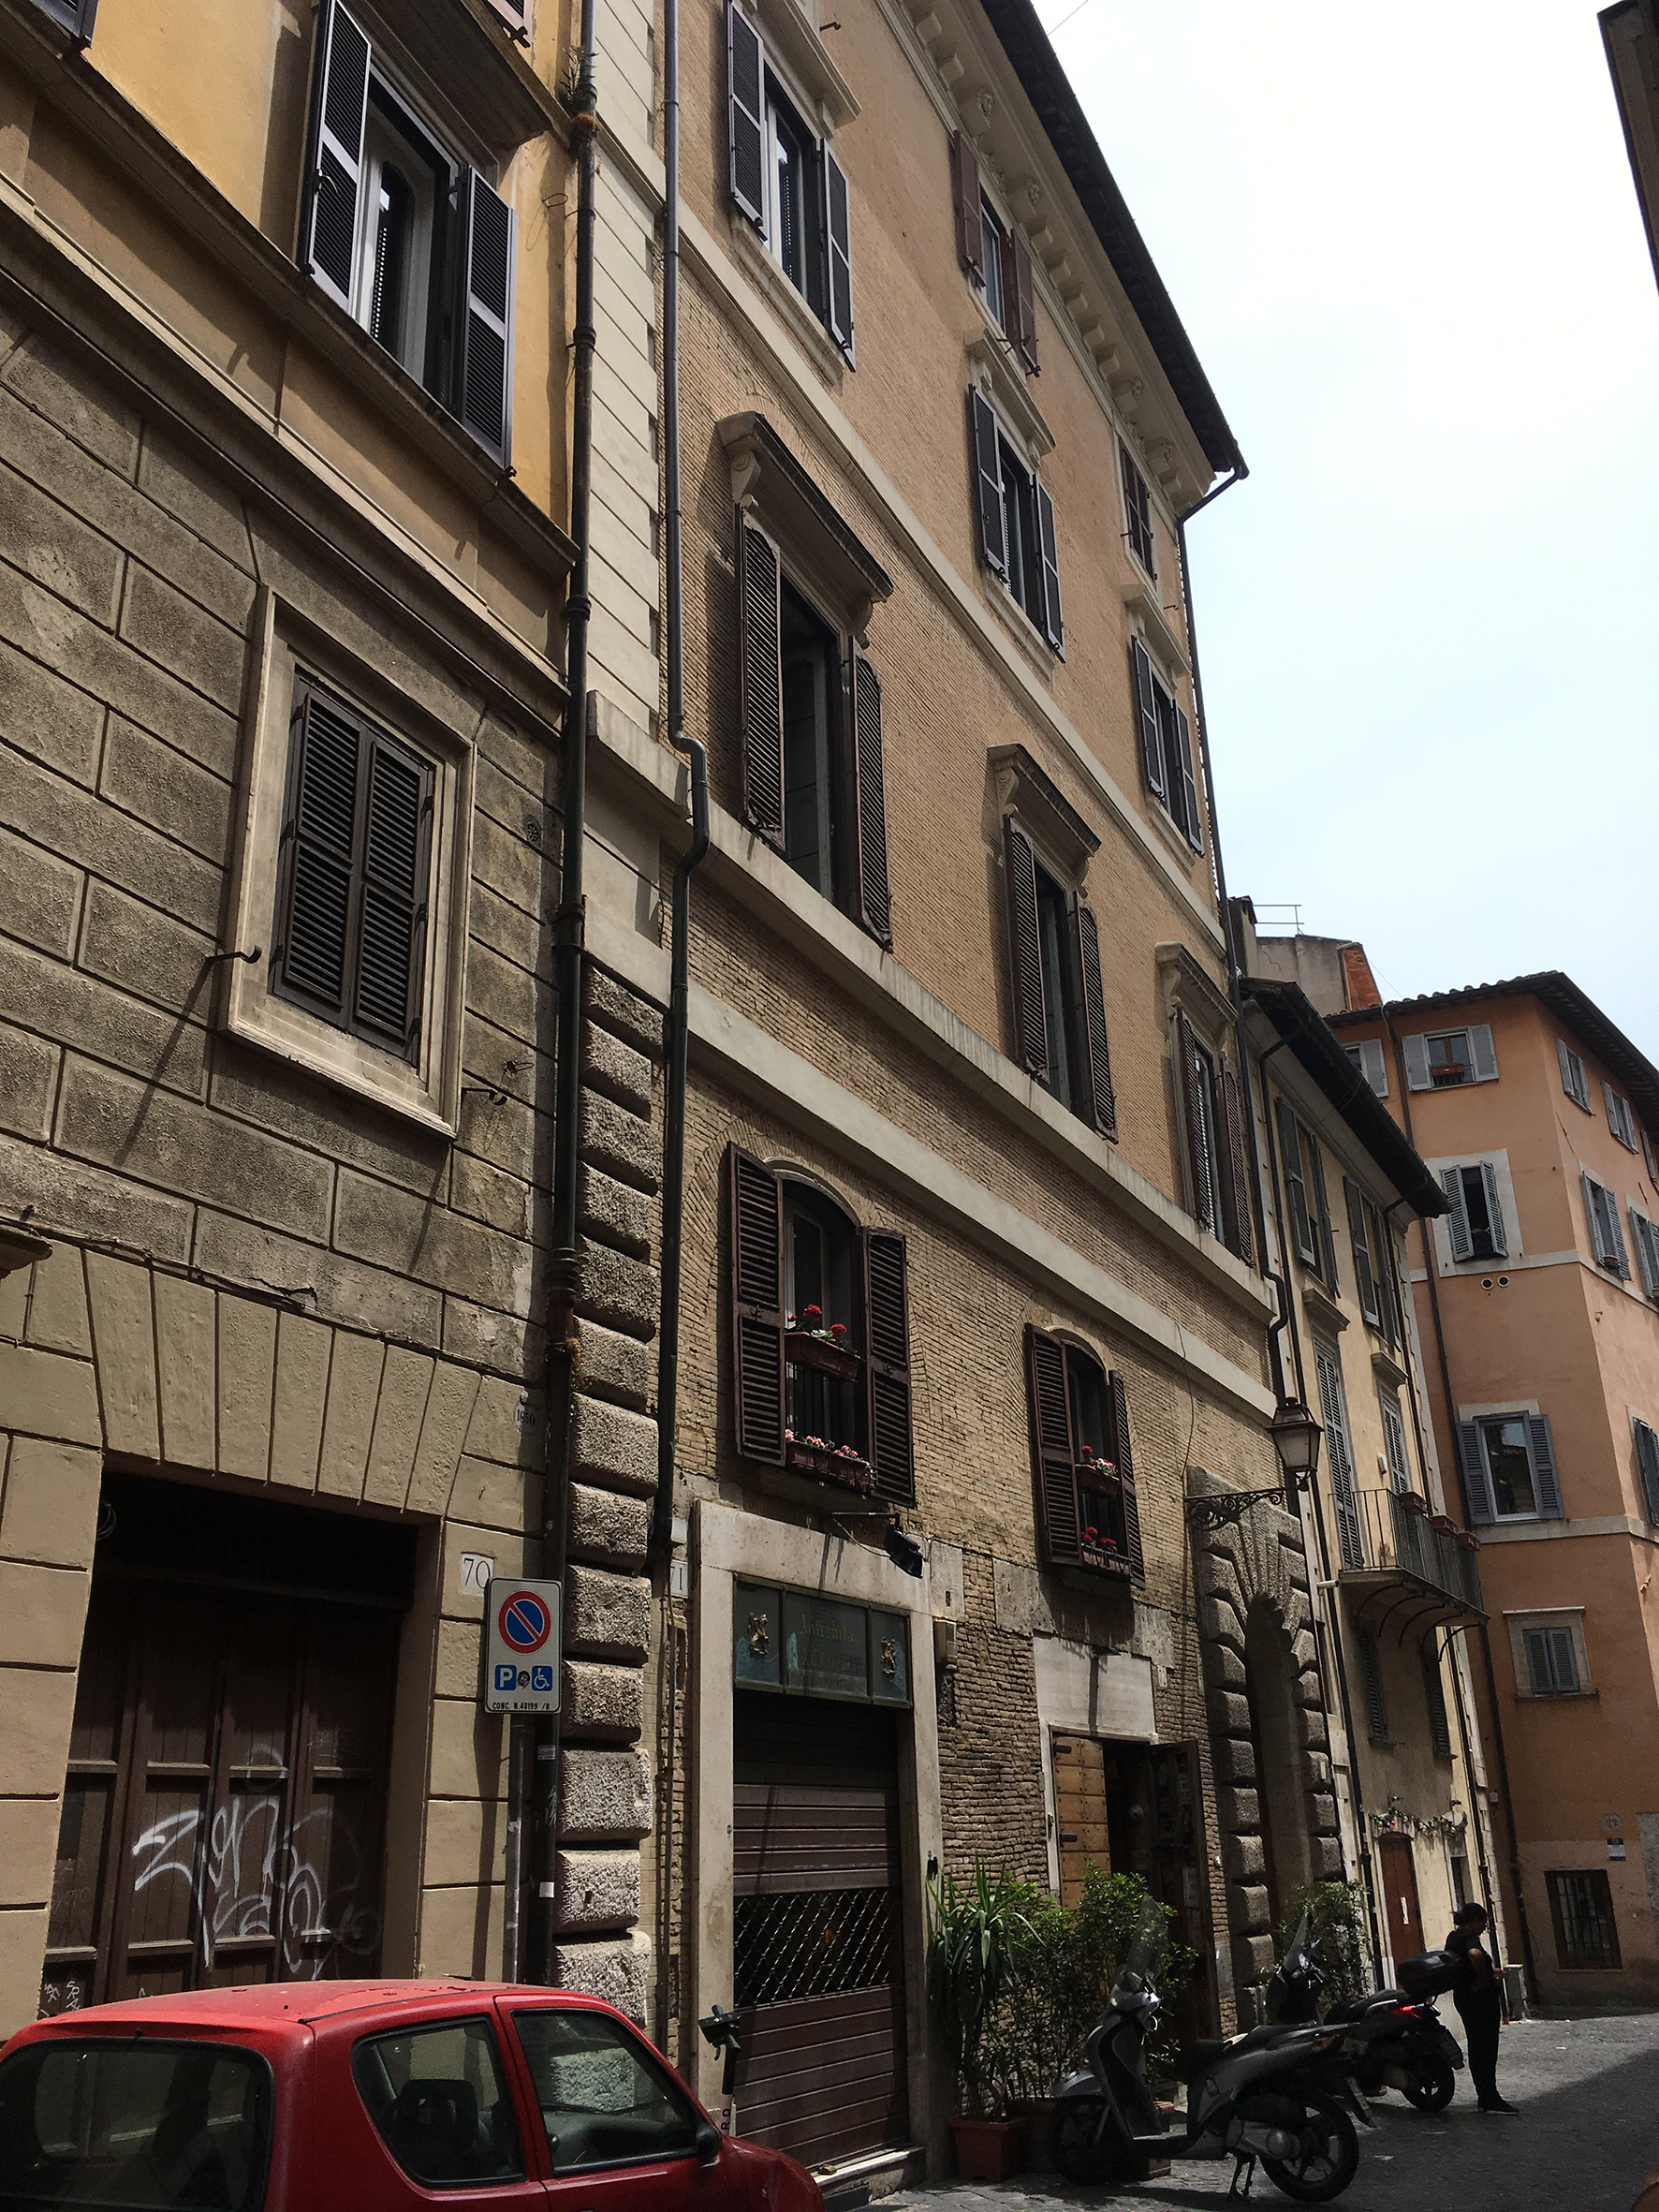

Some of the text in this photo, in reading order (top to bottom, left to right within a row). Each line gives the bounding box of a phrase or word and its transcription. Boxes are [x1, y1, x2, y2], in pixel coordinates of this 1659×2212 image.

[517, 1408, 536, 1426] 1650
[462, 1557, 492, 1589] 70
[499, 1667, 514, 1688] P
